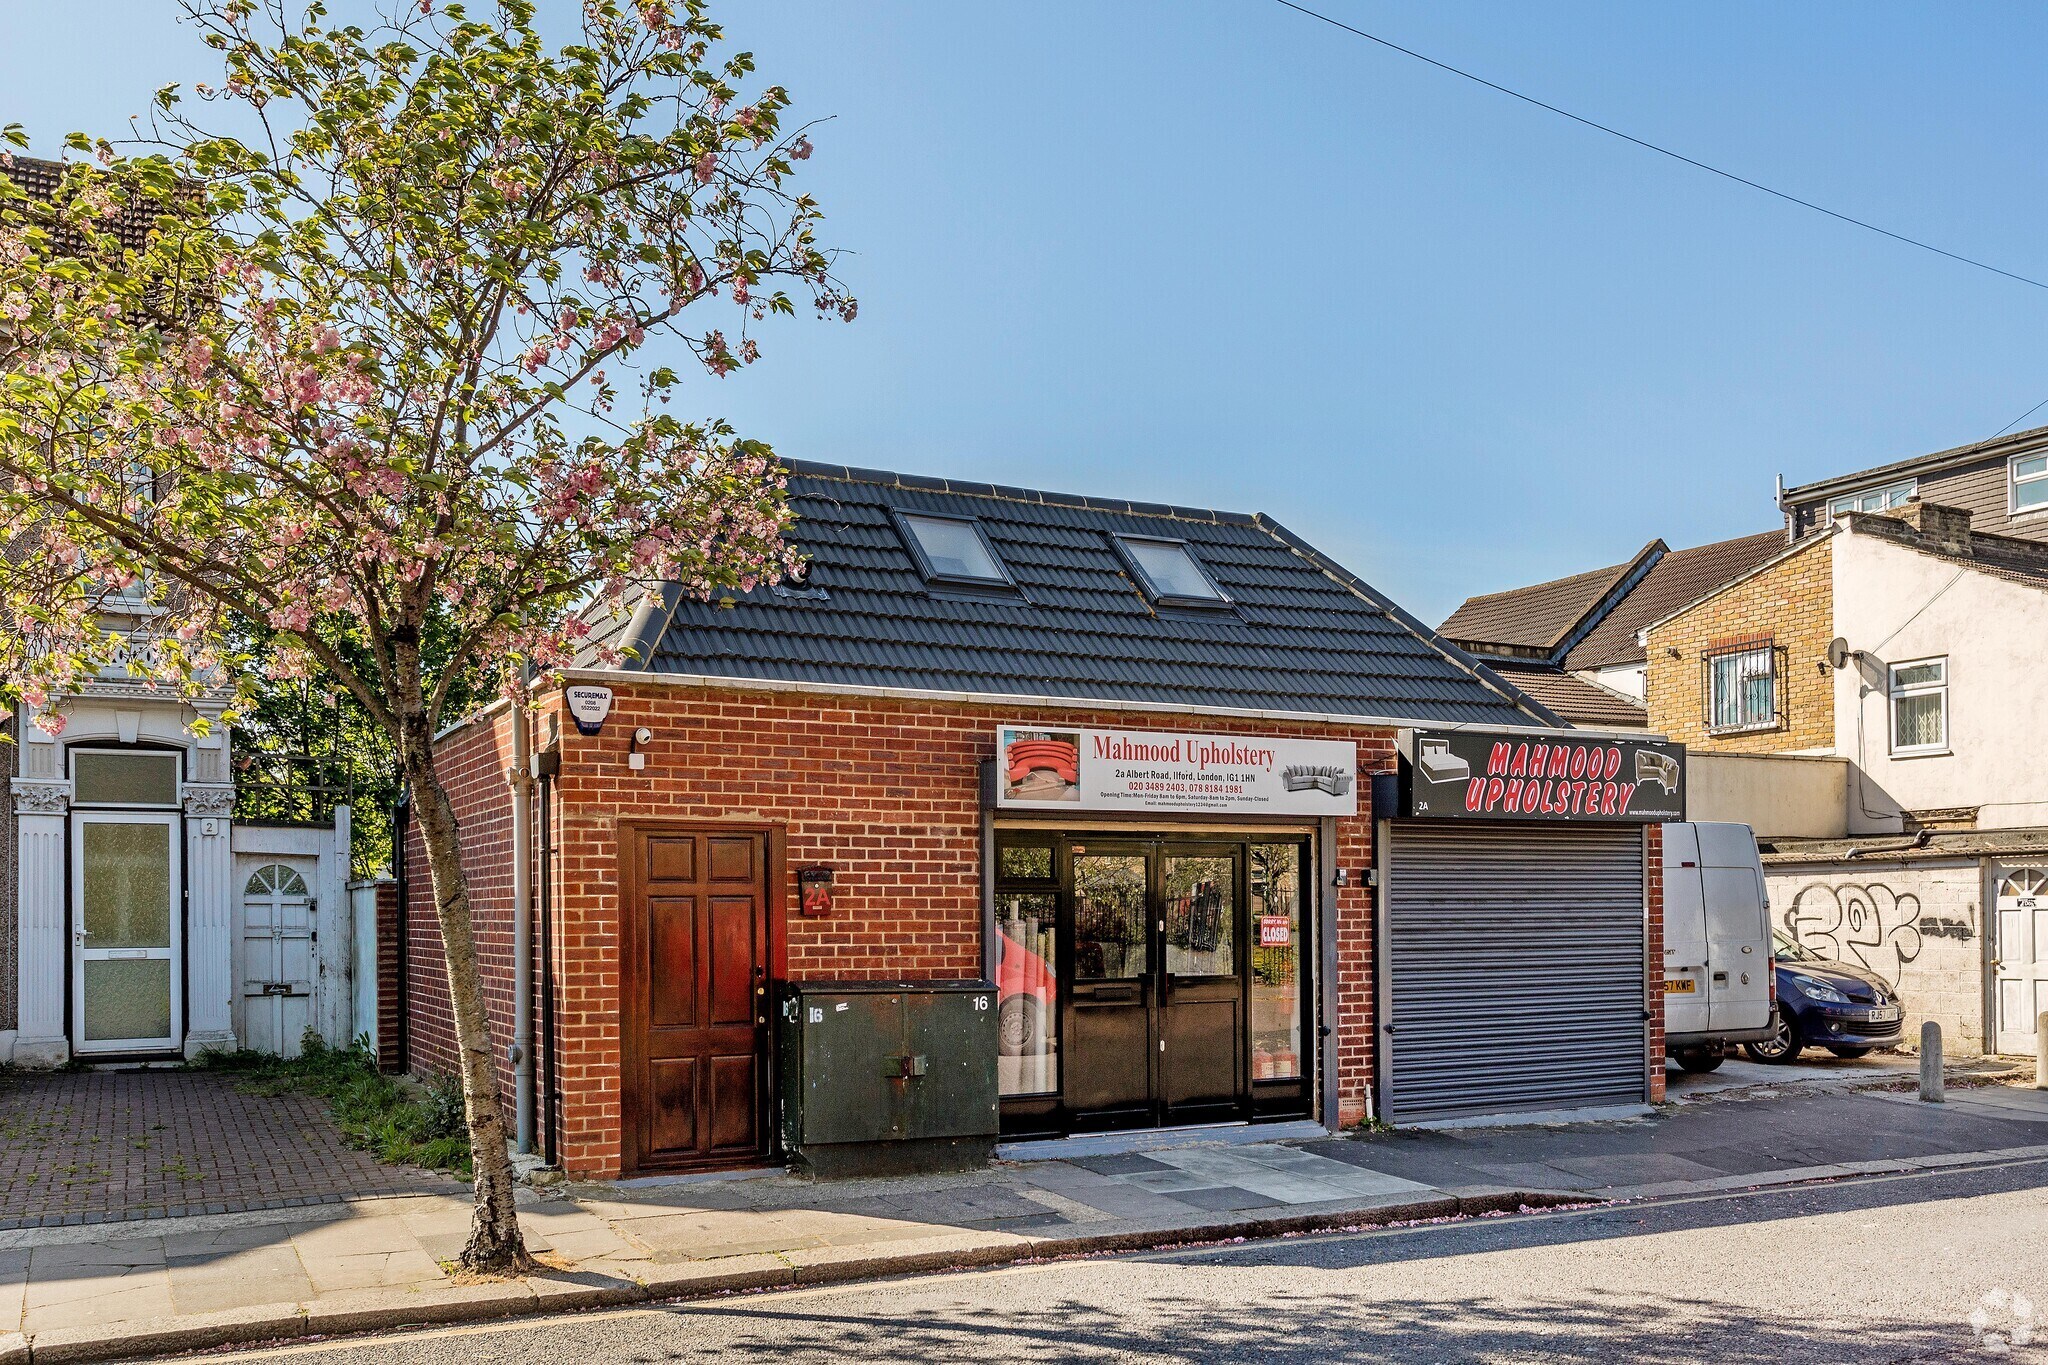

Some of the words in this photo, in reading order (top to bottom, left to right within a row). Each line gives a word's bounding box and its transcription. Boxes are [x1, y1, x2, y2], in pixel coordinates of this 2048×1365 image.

[573, 691, 607, 699] SECUREMAX
[1092, 735, 1180, 763] Mahmood
[1186, 739, 1276, 772] Upholstery
[1487, 741, 1622, 781] MAHMOOD
[1115, 769, 1125, 778] 2a
[1126, 769, 1149, 779] Albert
[1151, 770, 1172, 781] Road,
[1173, 771, 1195, 781] Ilford,
[1197, 772, 1225, 783] London,
[1226, 773, 1239, 782] IG1
[1241, 774, 1256, 783] 1HN
[1100, 791, 1120, 799] Opening
[1128, 781, 1143, 791] 020
[1145, 781, 1164, 791] 3489
[1165, 782, 1187, 792] 2403,
[1189, 783, 1203, 792] 078
[1204, 784, 1223, 793] 8184
[1225, 785, 1243, 794] 1981
[1465, 777, 1635, 815] UPHOLSTERY
[1418, 801, 1428, 810] 2A
[206, 822, 213, 832] 2
[804, 887, 830, 906] 2A
[1263, 926, 1288, 942] CLOSED
[973, 995, 989, 1011] 16
[809, 1006, 823, 1023] 16
